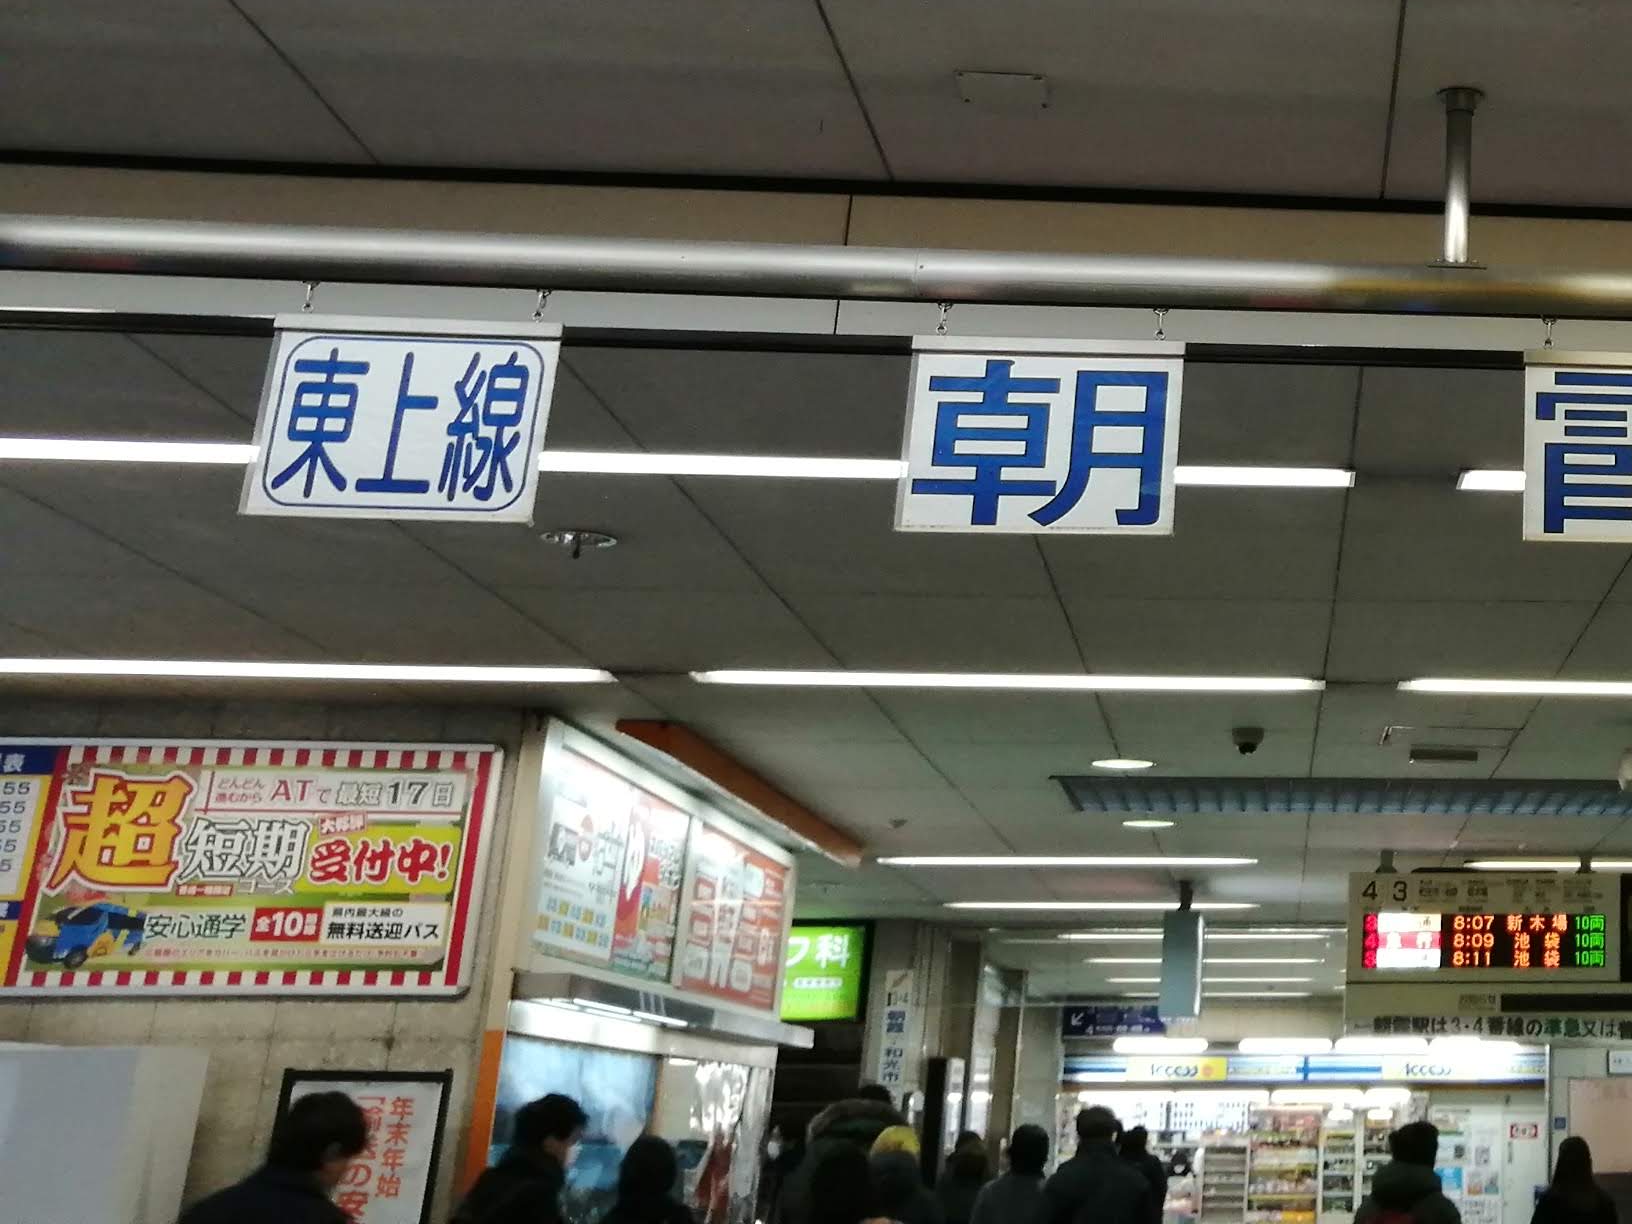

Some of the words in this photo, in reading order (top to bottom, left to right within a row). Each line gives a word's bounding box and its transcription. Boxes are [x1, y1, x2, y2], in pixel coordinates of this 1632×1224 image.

[271, 347, 530, 502] 東上線
[911, 359, 1169, 527] 朝
[217, 779, 265, 790] どんどん
[48, 771, 193, 889] 超
[1362, 880, 1378, 901] 4
[1393, 880, 1408, 902] 3
[146, 913, 246, 939] 安心通学
[326, 922, 441, 941] 無料送迎バス
[1453, 915, 1495, 931] 8:07
[1453, 933, 1495, 948] 8:09
[1452, 950, 1493, 966] 8:11
[375, 1096, 414, 1198] 年末年始
